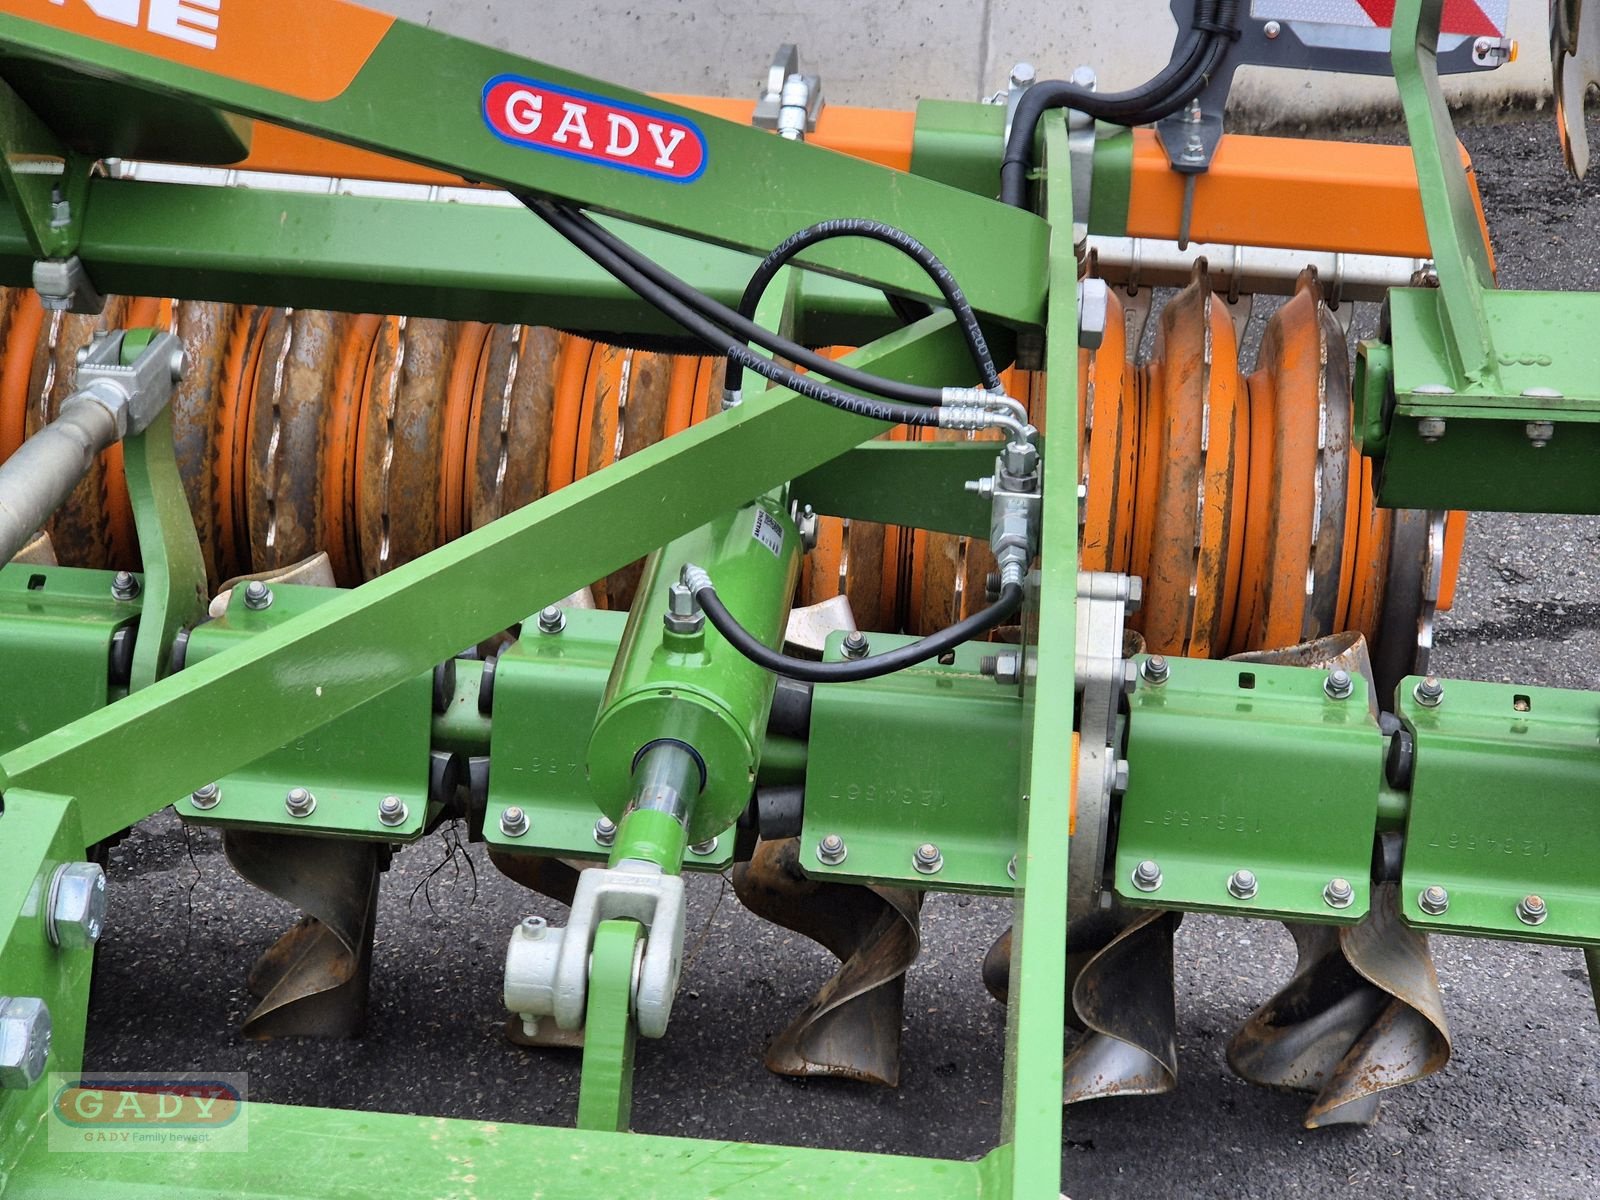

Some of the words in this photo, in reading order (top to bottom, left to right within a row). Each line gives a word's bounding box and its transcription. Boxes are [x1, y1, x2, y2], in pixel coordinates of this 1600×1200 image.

[505, 90, 685, 168] GADY
[727, 343, 785, 379] AMAZONE
[901, 410, 937, 424] 1/4"
